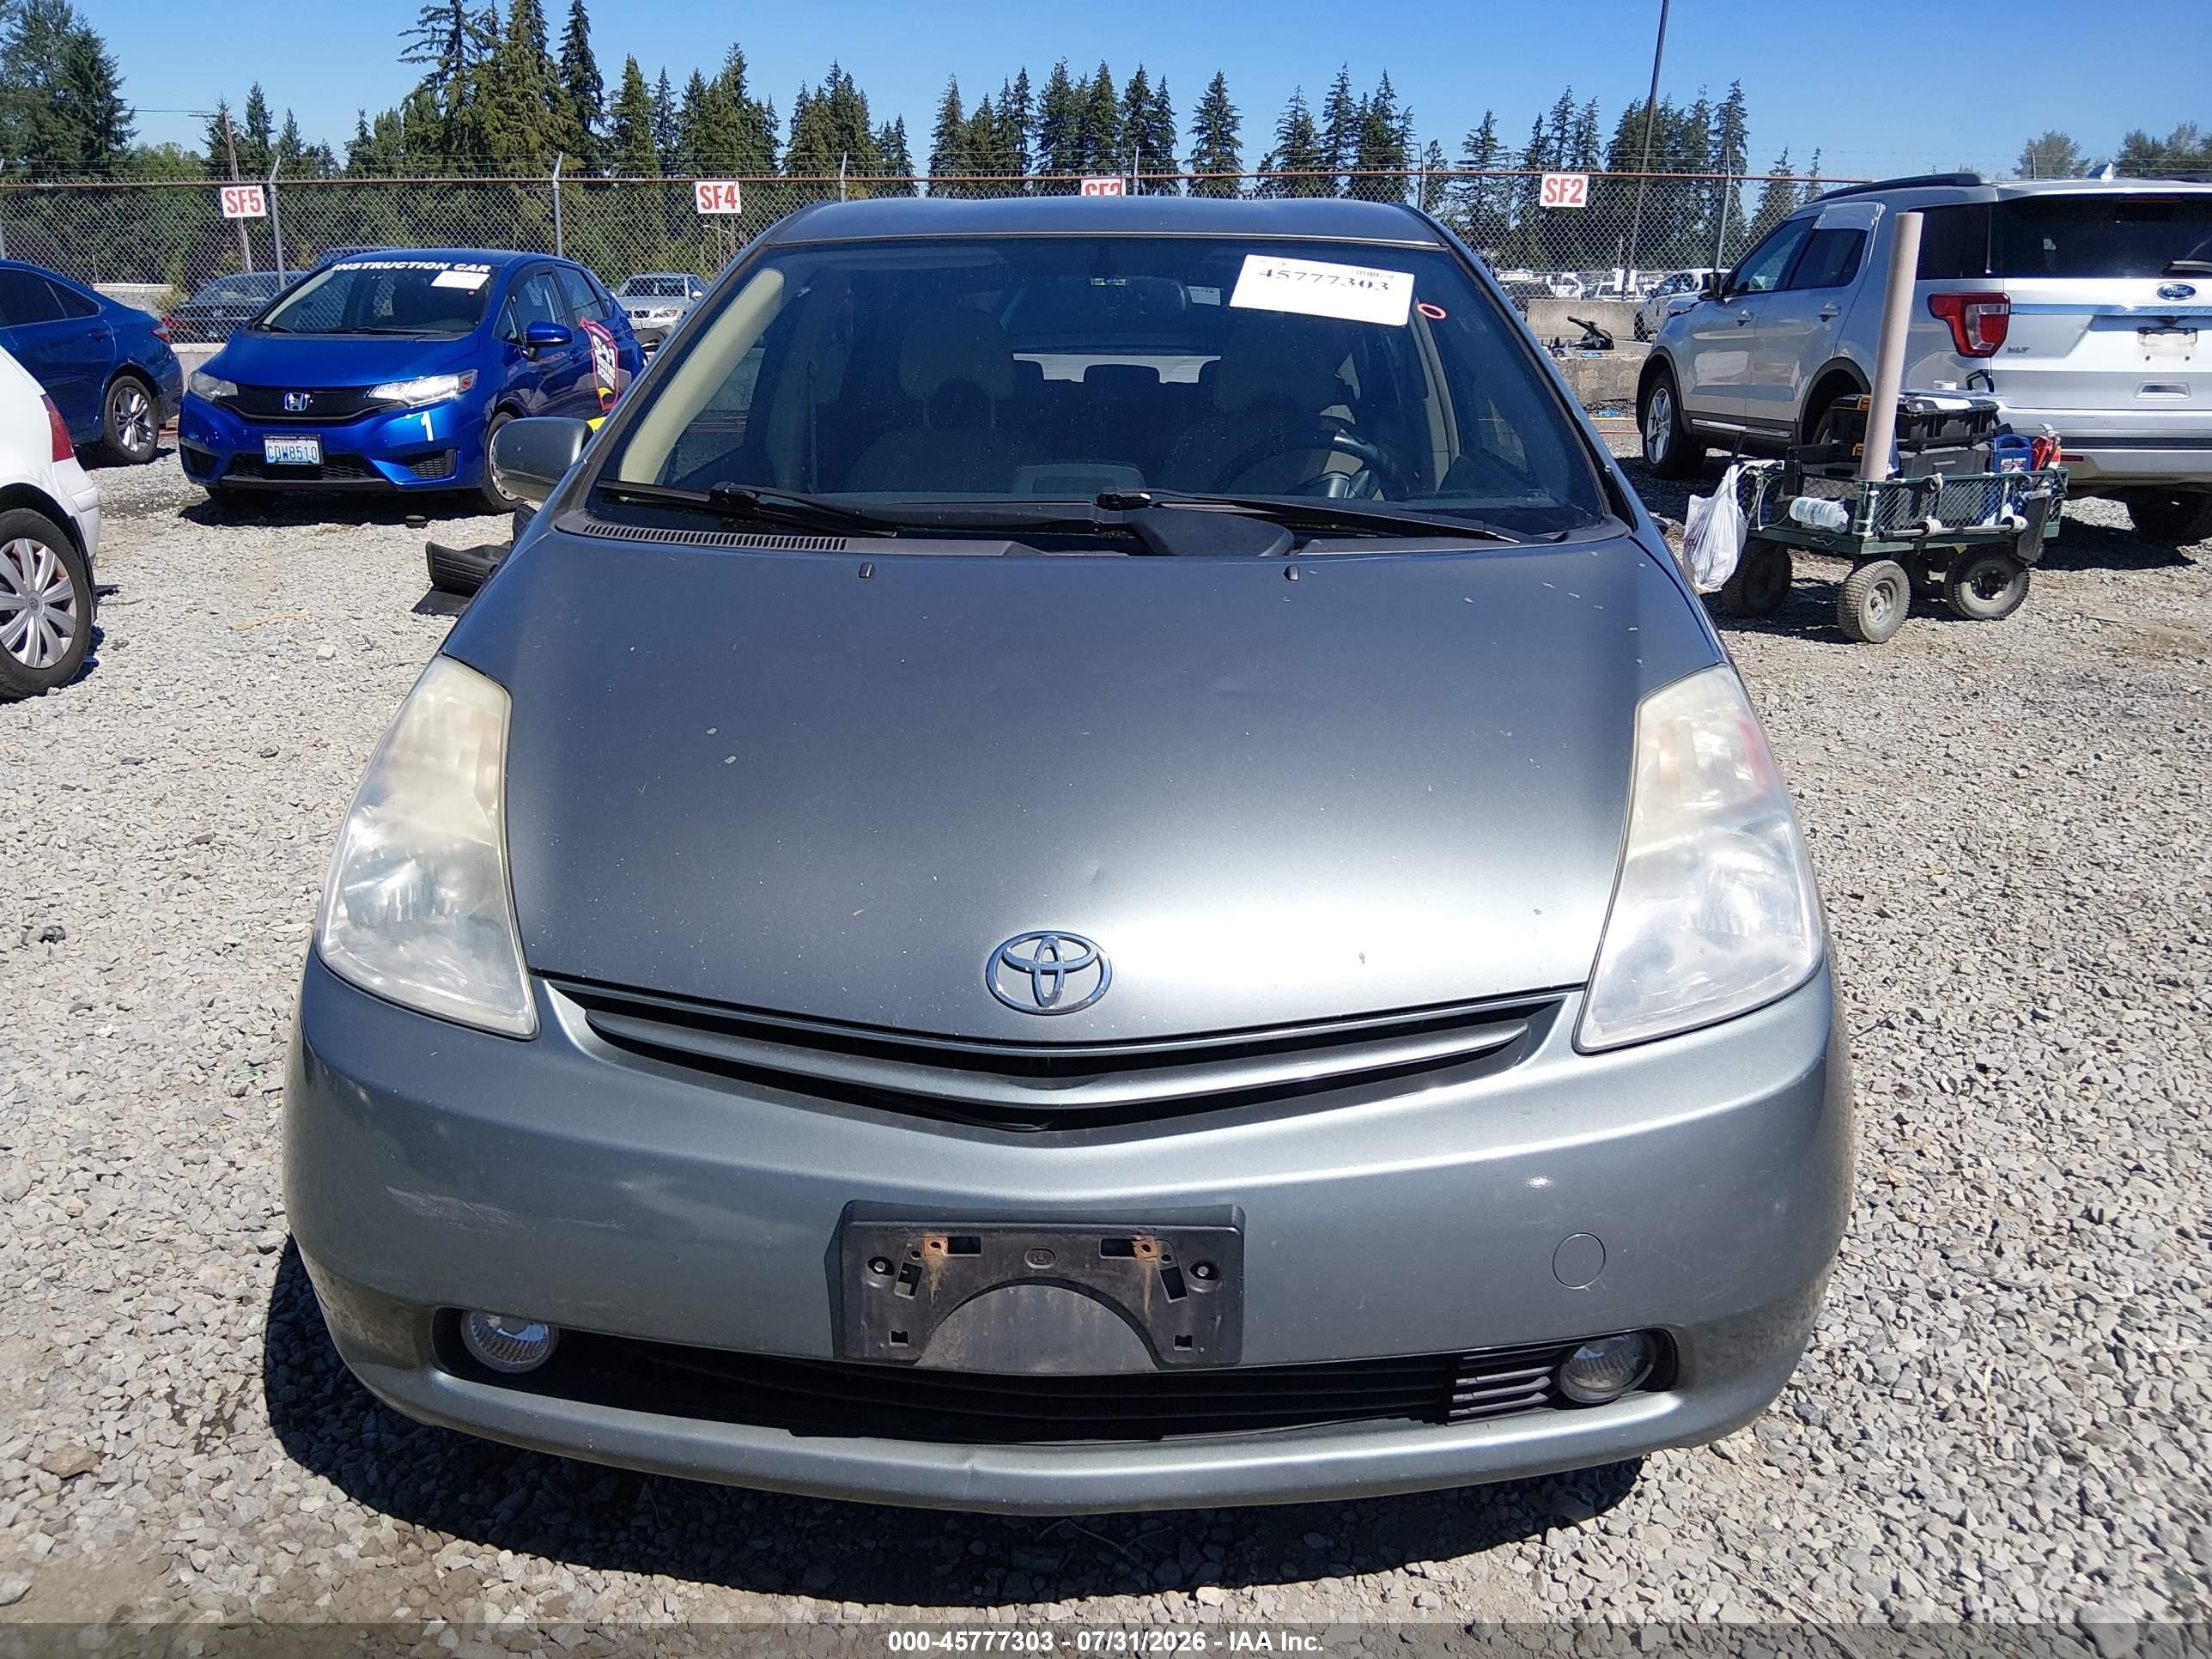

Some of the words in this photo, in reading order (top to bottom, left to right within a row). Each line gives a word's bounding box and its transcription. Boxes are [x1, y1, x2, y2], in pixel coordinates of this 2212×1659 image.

[224, 189, 262, 214] SF5
[699, 185, 738, 210] SF4
[1544, 177, 1584, 204] SF2
[331, 261, 451, 272] INSTRUCTION
[453, 263, 492, 273] CAR
[1259, 268, 1390, 292] 45777303
[420, 410, 434, 441] 1
